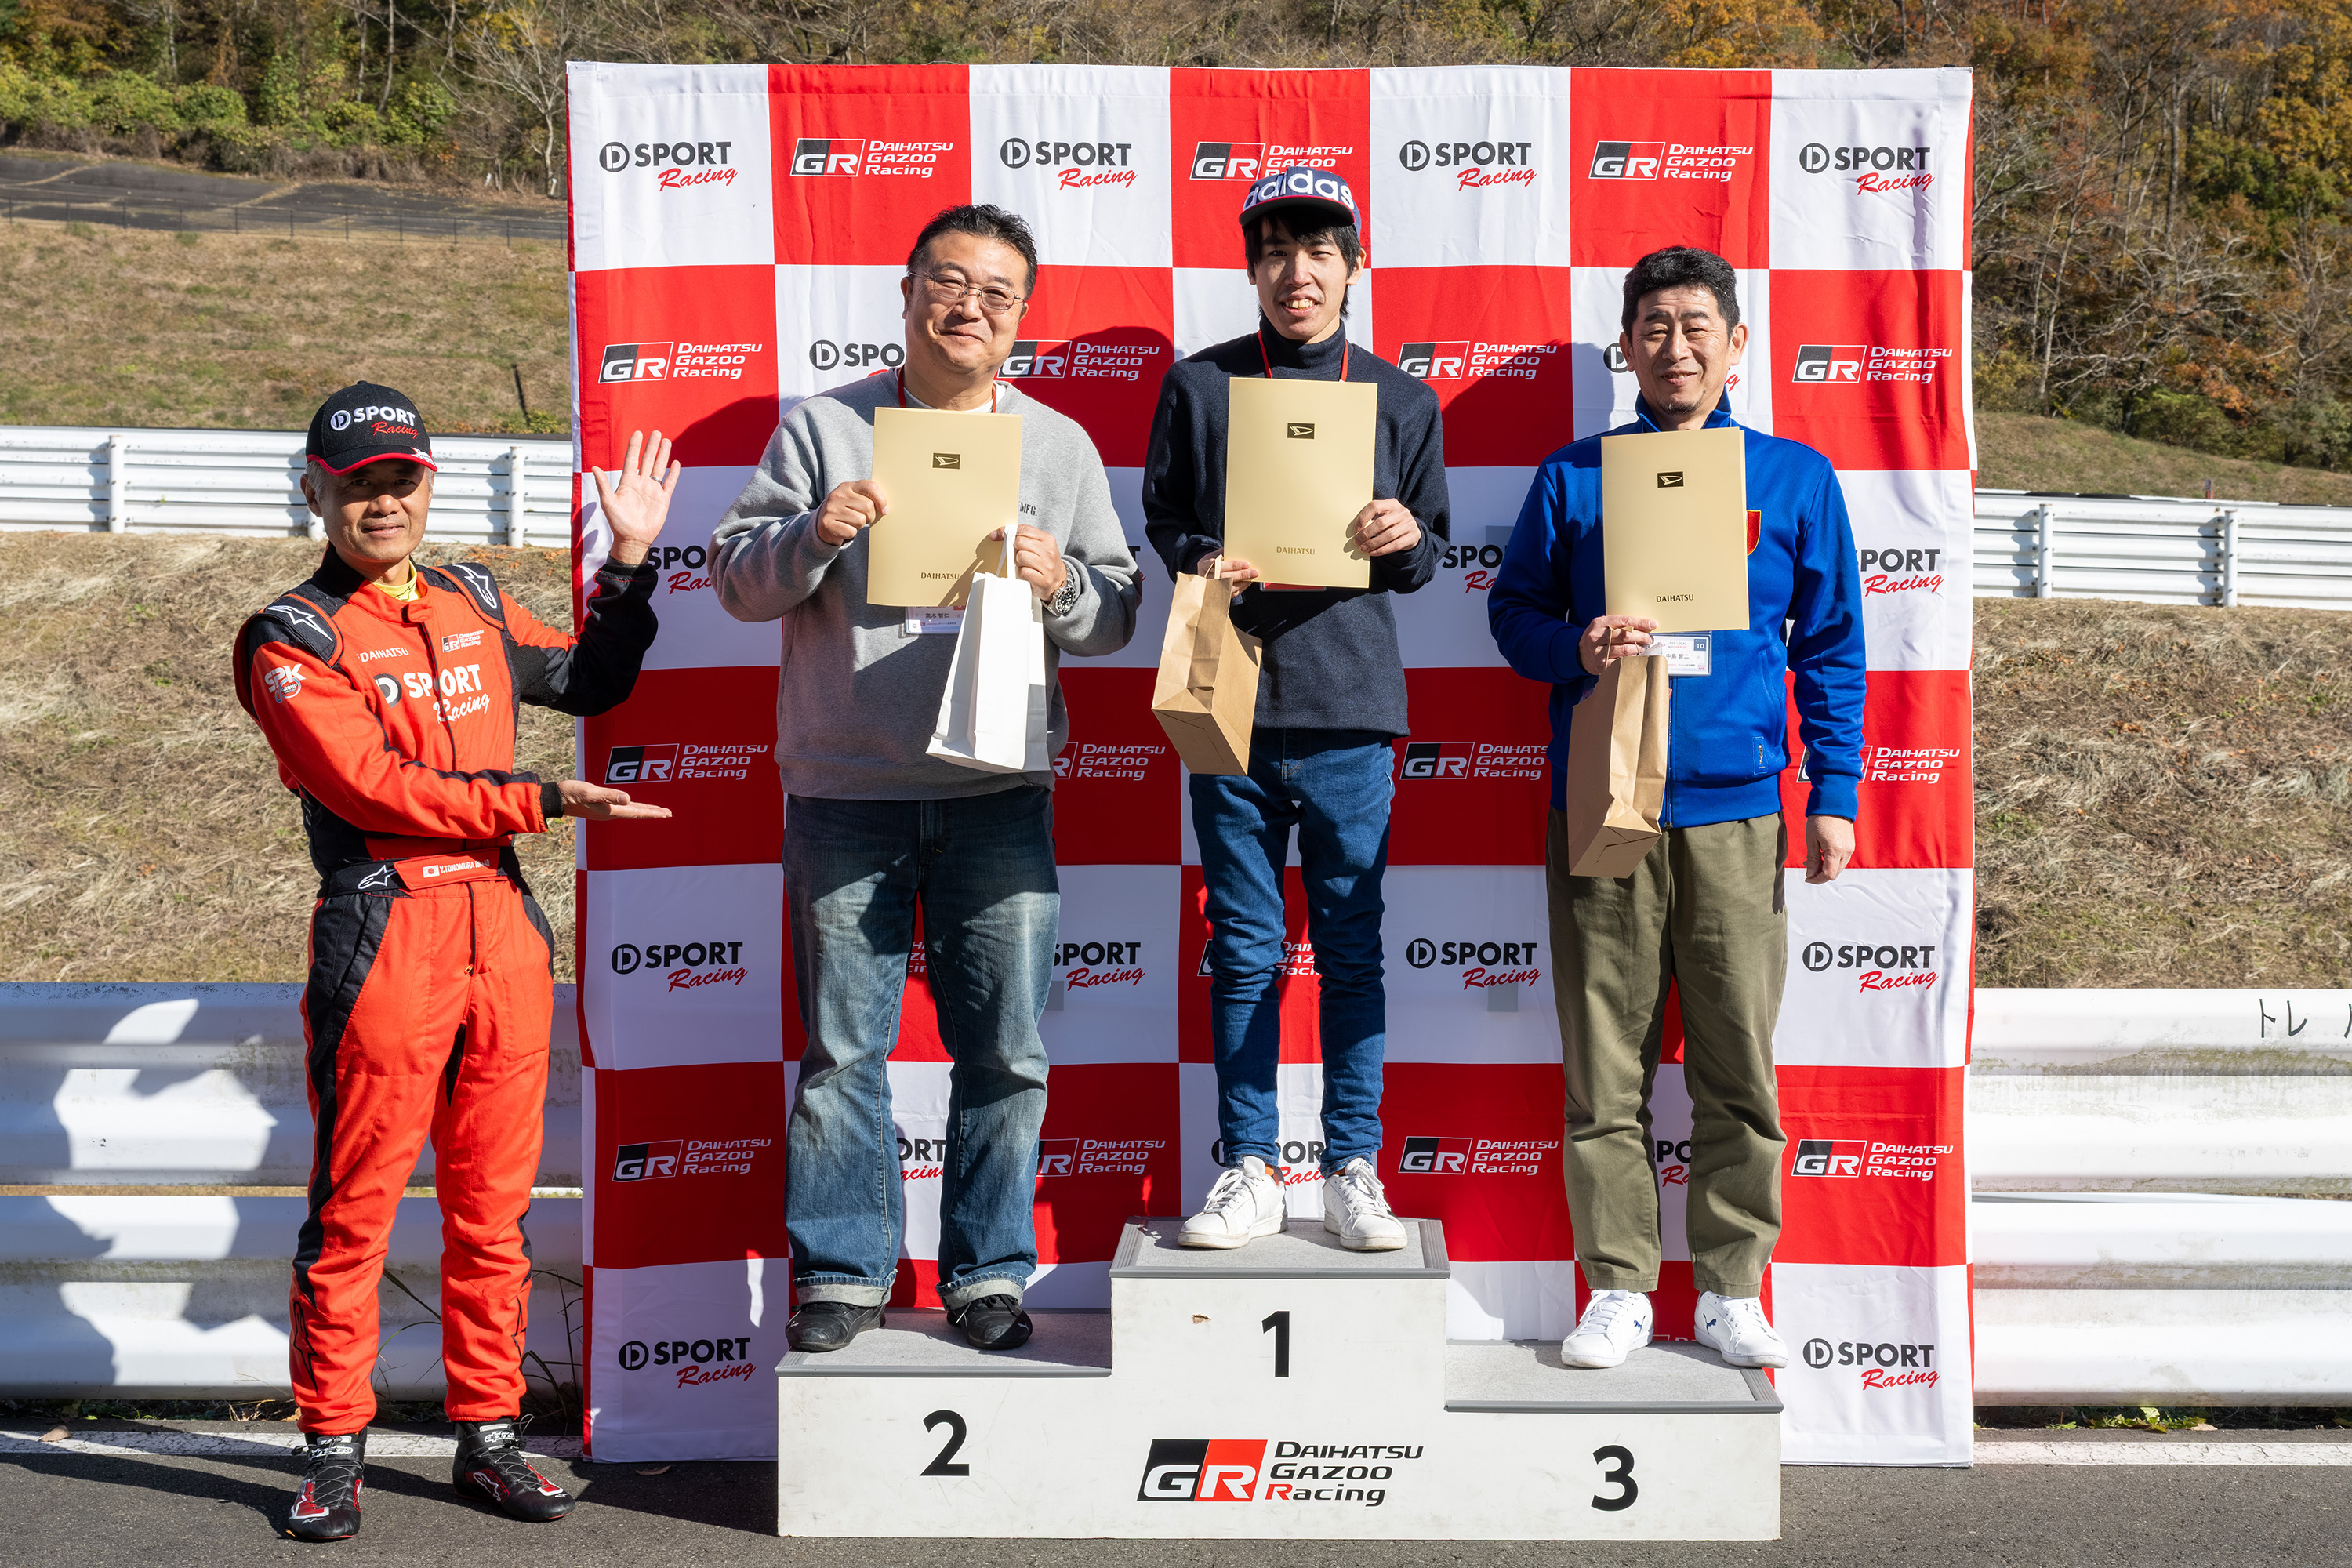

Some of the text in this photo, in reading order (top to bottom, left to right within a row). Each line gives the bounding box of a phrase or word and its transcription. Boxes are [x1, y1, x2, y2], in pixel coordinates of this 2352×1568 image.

[869, 140, 953, 151] DAIHATSU
[1036, 141, 1131, 166] SPORT
[1269, 146, 1353, 155] DAIHATSU
[1436, 141, 1531, 166] SPORT
[1669, 143, 1753, 155] DAIHATSU
[635, 142, 731, 167] SPORT
[867, 153, 936, 162] GAZOO
[1267, 158, 1335, 167] GAZOO
[1667, 156, 1736, 166] GAZOO
[1835, 147, 1930, 172] SPORT
[795, 154, 858, 175] GR
[865, 165, 933, 178] Racing
[1195, 158, 1258, 178] GR
[1594, 158, 1657, 178] GR
[658, 169, 737, 191] Racing
[1058, 168, 1137, 190] Racing
[1457, 168, 1536, 191] Racing
[1664, 168, 1732, 182] Racing
[1857, 172, 1934, 195] Racing
[1243, 170, 1354, 210] adidas
[677, 343, 762, 353] DAIHATSU
[844, 343, 905, 367] SPO
[1076, 343, 1160, 354] DAIHATSU
[1473, 342, 1557, 353] DAIHATSU
[1871, 347, 1953, 357] DAIHATSU
[676, 355, 745, 368] GAZOO
[1001, 357, 1065, 377] GR
[1074, 355, 1142, 365] GAZOO
[1403, 358, 1466, 378] GR
[1472, 355, 1541, 365] GAZOO
[1869, 359, 1936, 368] GAZOO
[604, 359, 666, 379] GR
[673, 367, 742, 379] Racing
[1072, 367, 1138, 380] Racing
[1471, 367, 1536, 379] Racing
[1797, 361, 1860, 382] GR
[1867, 371, 1932, 383] Racing
[353, 405, 416, 426] SPORT
[371, 421, 419, 439] Racing
[647, 546, 706, 570] SPO
[1276, 546, 1316, 555] DAIHATSU
[1442, 545, 1502, 569] SPO
[1860, 549, 1940, 572] PORT
[1864, 575, 1943, 597] Racing
[1656, 593, 1694, 602] DAIHATSU
[360, 647, 409, 662] DAIHATSU
[264, 663, 307, 693] SPK
[403, 664, 482, 698] SPORT
[433, 693, 490, 724] Racing
[684, 744, 768, 755] DAIHATSU
[1083, 744, 1166, 754] DAIHATSU
[1479, 744, 1548, 754] DAIHATS
[1876, 747, 1960, 758] DAIHATSU
[609, 760, 673, 781] GR
[681, 757, 750, 769] GAZOO
[1080, 757, 1148, 769] GAZOO
[1404, 759, 1468, 779] GR
[1476, 756, 1544, 769] GAZOO
[1875, 760, 1943, 773] GAZOO
[679, 769, 746, 779] Racing
[1077, 768, 1145, 780] Racing
[1474, 768, 1541, 780] Racing
[1871, 771, 1940, 783] Racing
[645, 942, 742, 968] SPORT
[1441, 942, 1537, 966] SPORT
[1837, 946, 1935, 968] SPORT
[667, 967, 747, 992] Racing
[1066, 968, 1145, 991] Racing
[1463, 968, 1541, 990] Racing
[1859, 971, 1938, 993] Racing
[687, 1139, 771, 1150] DAIHATSU
[1082, 1139, 1166, 1149] DAIHATSU
[1476, 1139, 1559, 1149] DAIHATSU
[1871, 1142, 1953, 1154] DAIHATSU
[684, 1150, 754, 1162] GAZOO
[1081, 1152, 1148, 1163] GAZOO
[1403, 1153, 1466, 1174] GR
[1475, 1152, 1541, 1161] GAZOO
[1869, 1155, 1936, 1165] GAZOO
[617, 1156, 681, 1176] GR
[685, 1164, 750, 1174] Racing
[1079, 1163, 1145, 1174] Racing
[1472, 1163, 1538, 1175] Racing
[1795, 1156, 1859, 1177] GR
[1866, 1167, 1933, 1181] Racing
[655, 1339, 750, 1363] SPORT
[1261, 1311, 1290, 1377] 1
[1838, 1342, 1934, 1367] SPORT
[677, 1363, 753, 1388] Racing
[1861, 1369, 1940, 1390] Racing
[920, 1410, 970, 1476] 2
[1274, 1441, 1424, 1459] DAIHATSU
[1270, 1463, 1393, 1479] GAZOO
[1591, 1445, 1639, 1512] 3
[1144, 1465, 1256, 1499] GR
[1265, 1483, 1386, 1507] Racing
